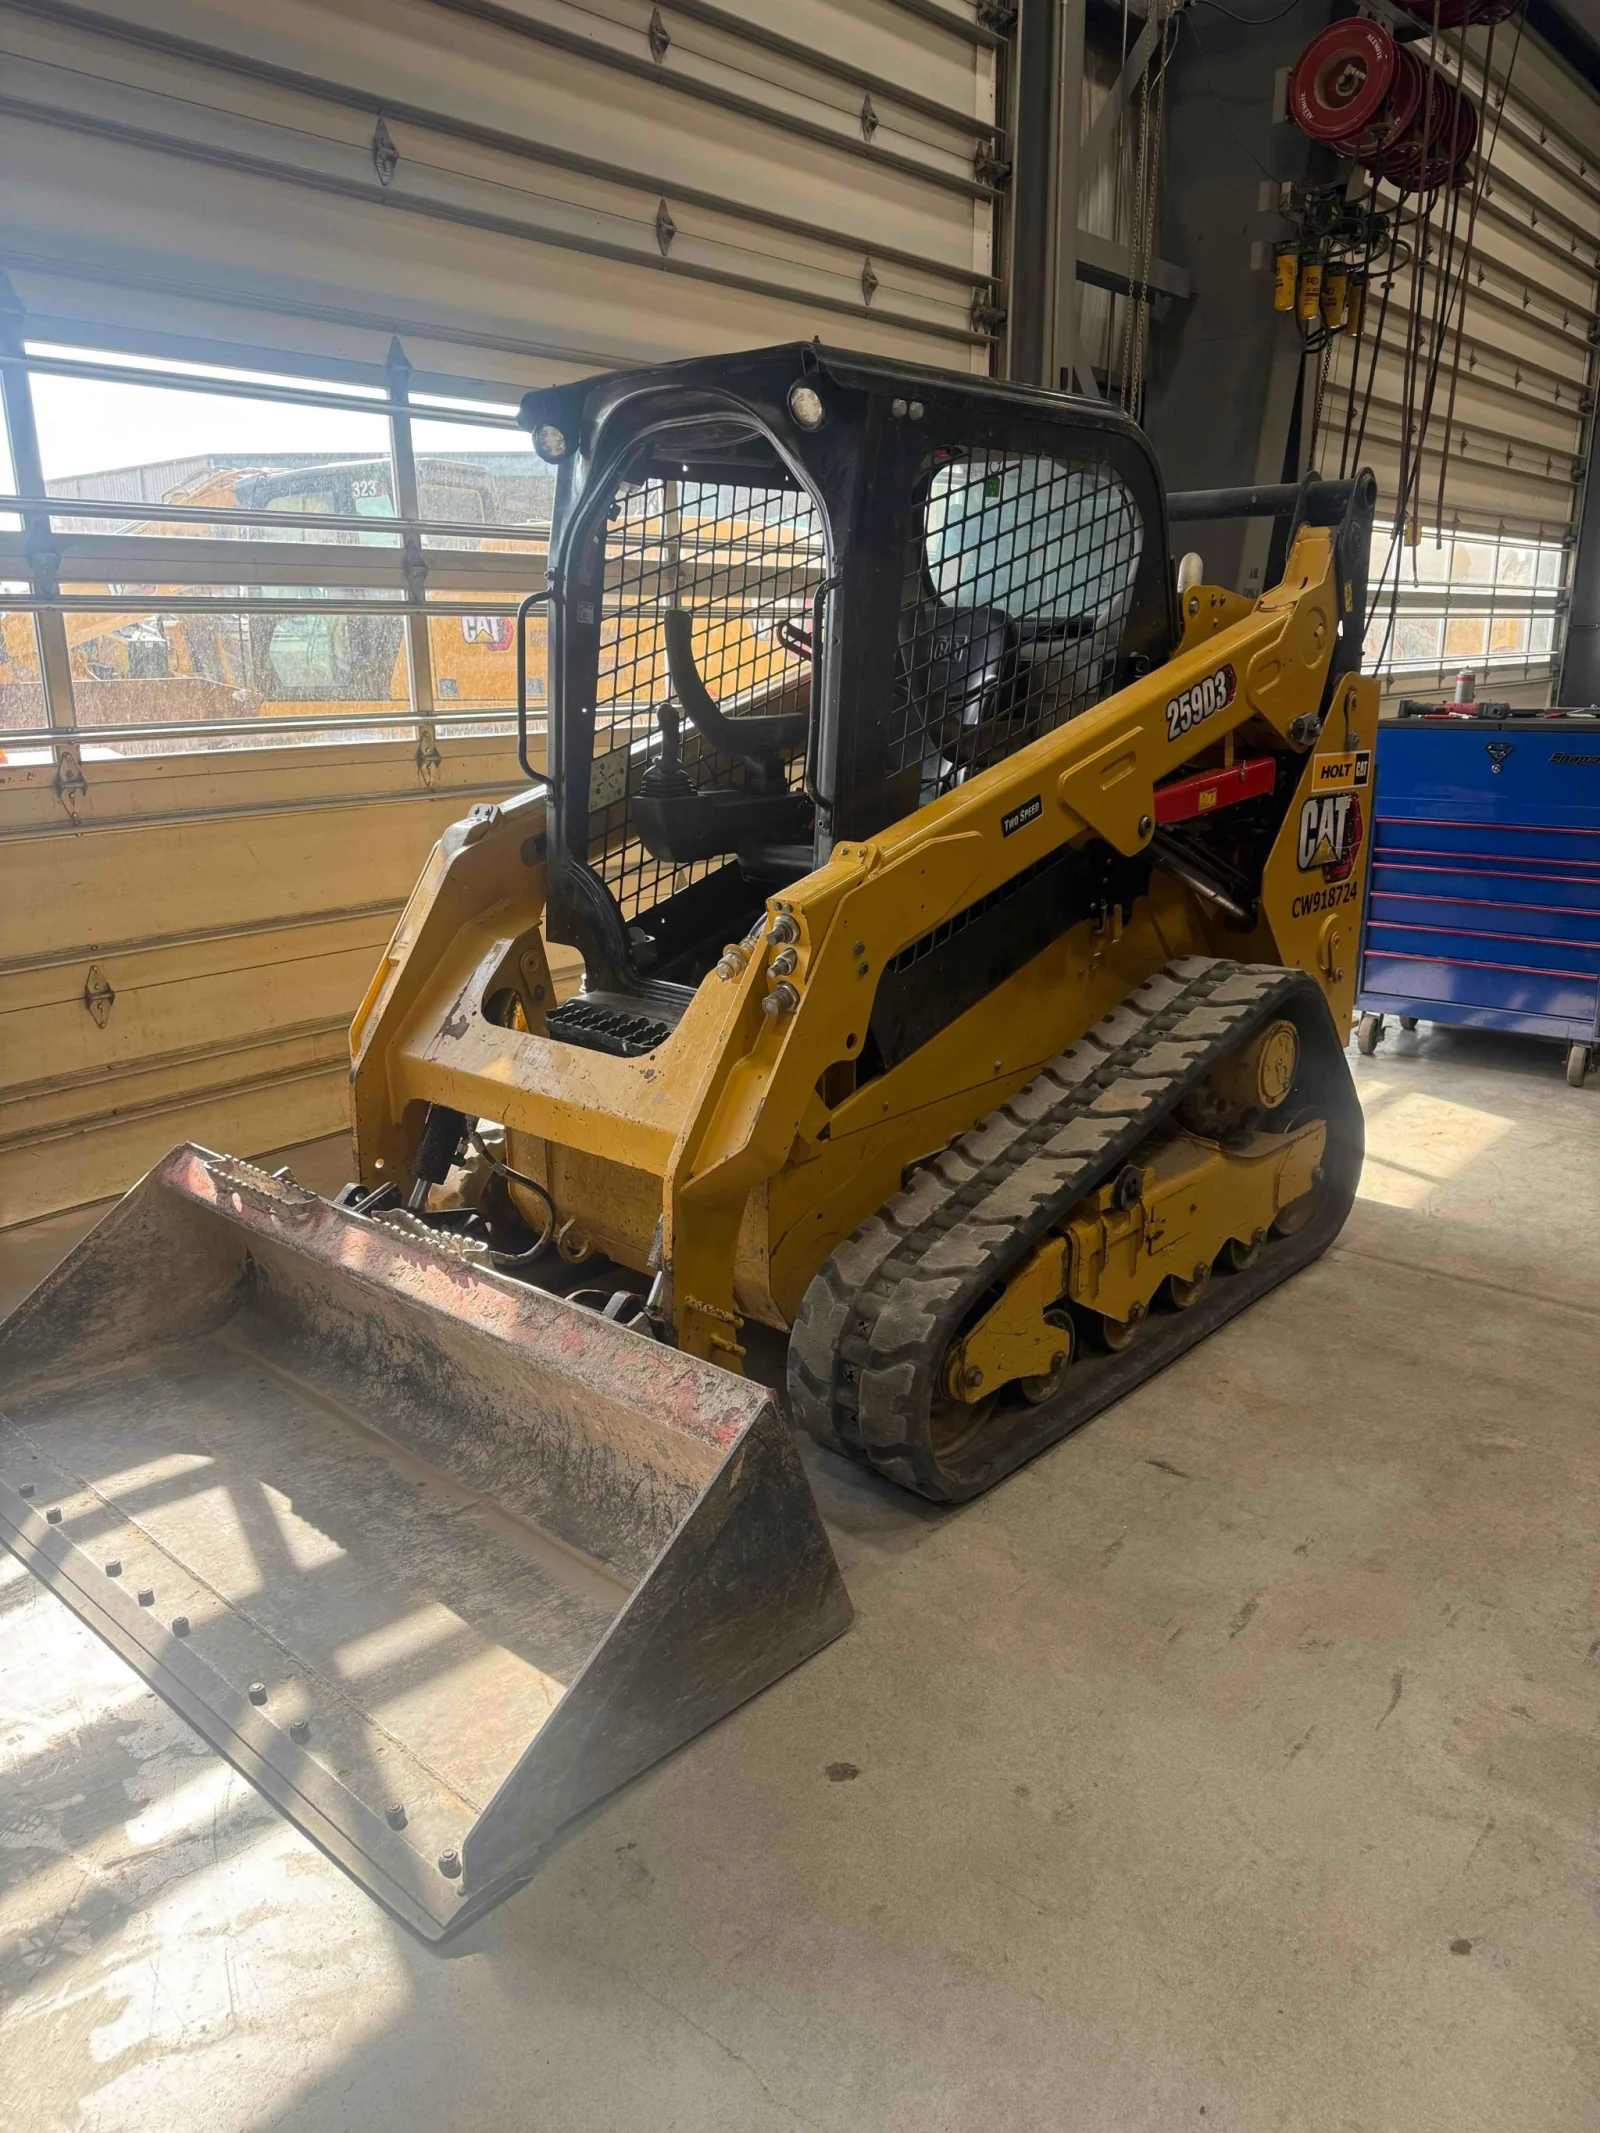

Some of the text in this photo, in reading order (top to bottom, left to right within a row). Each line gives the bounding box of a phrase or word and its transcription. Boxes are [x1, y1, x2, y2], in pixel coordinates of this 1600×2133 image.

[352, 480, 377, 498] 323
[462, 615, 502, 644] CAT
[1166, 670, 1227, 741] 259D3
[1320, 761, 1368, 779] HOLT CAT
[1298, 796, 1351, 869] CAT
[1292, 881, 1357, 918] CW918724
